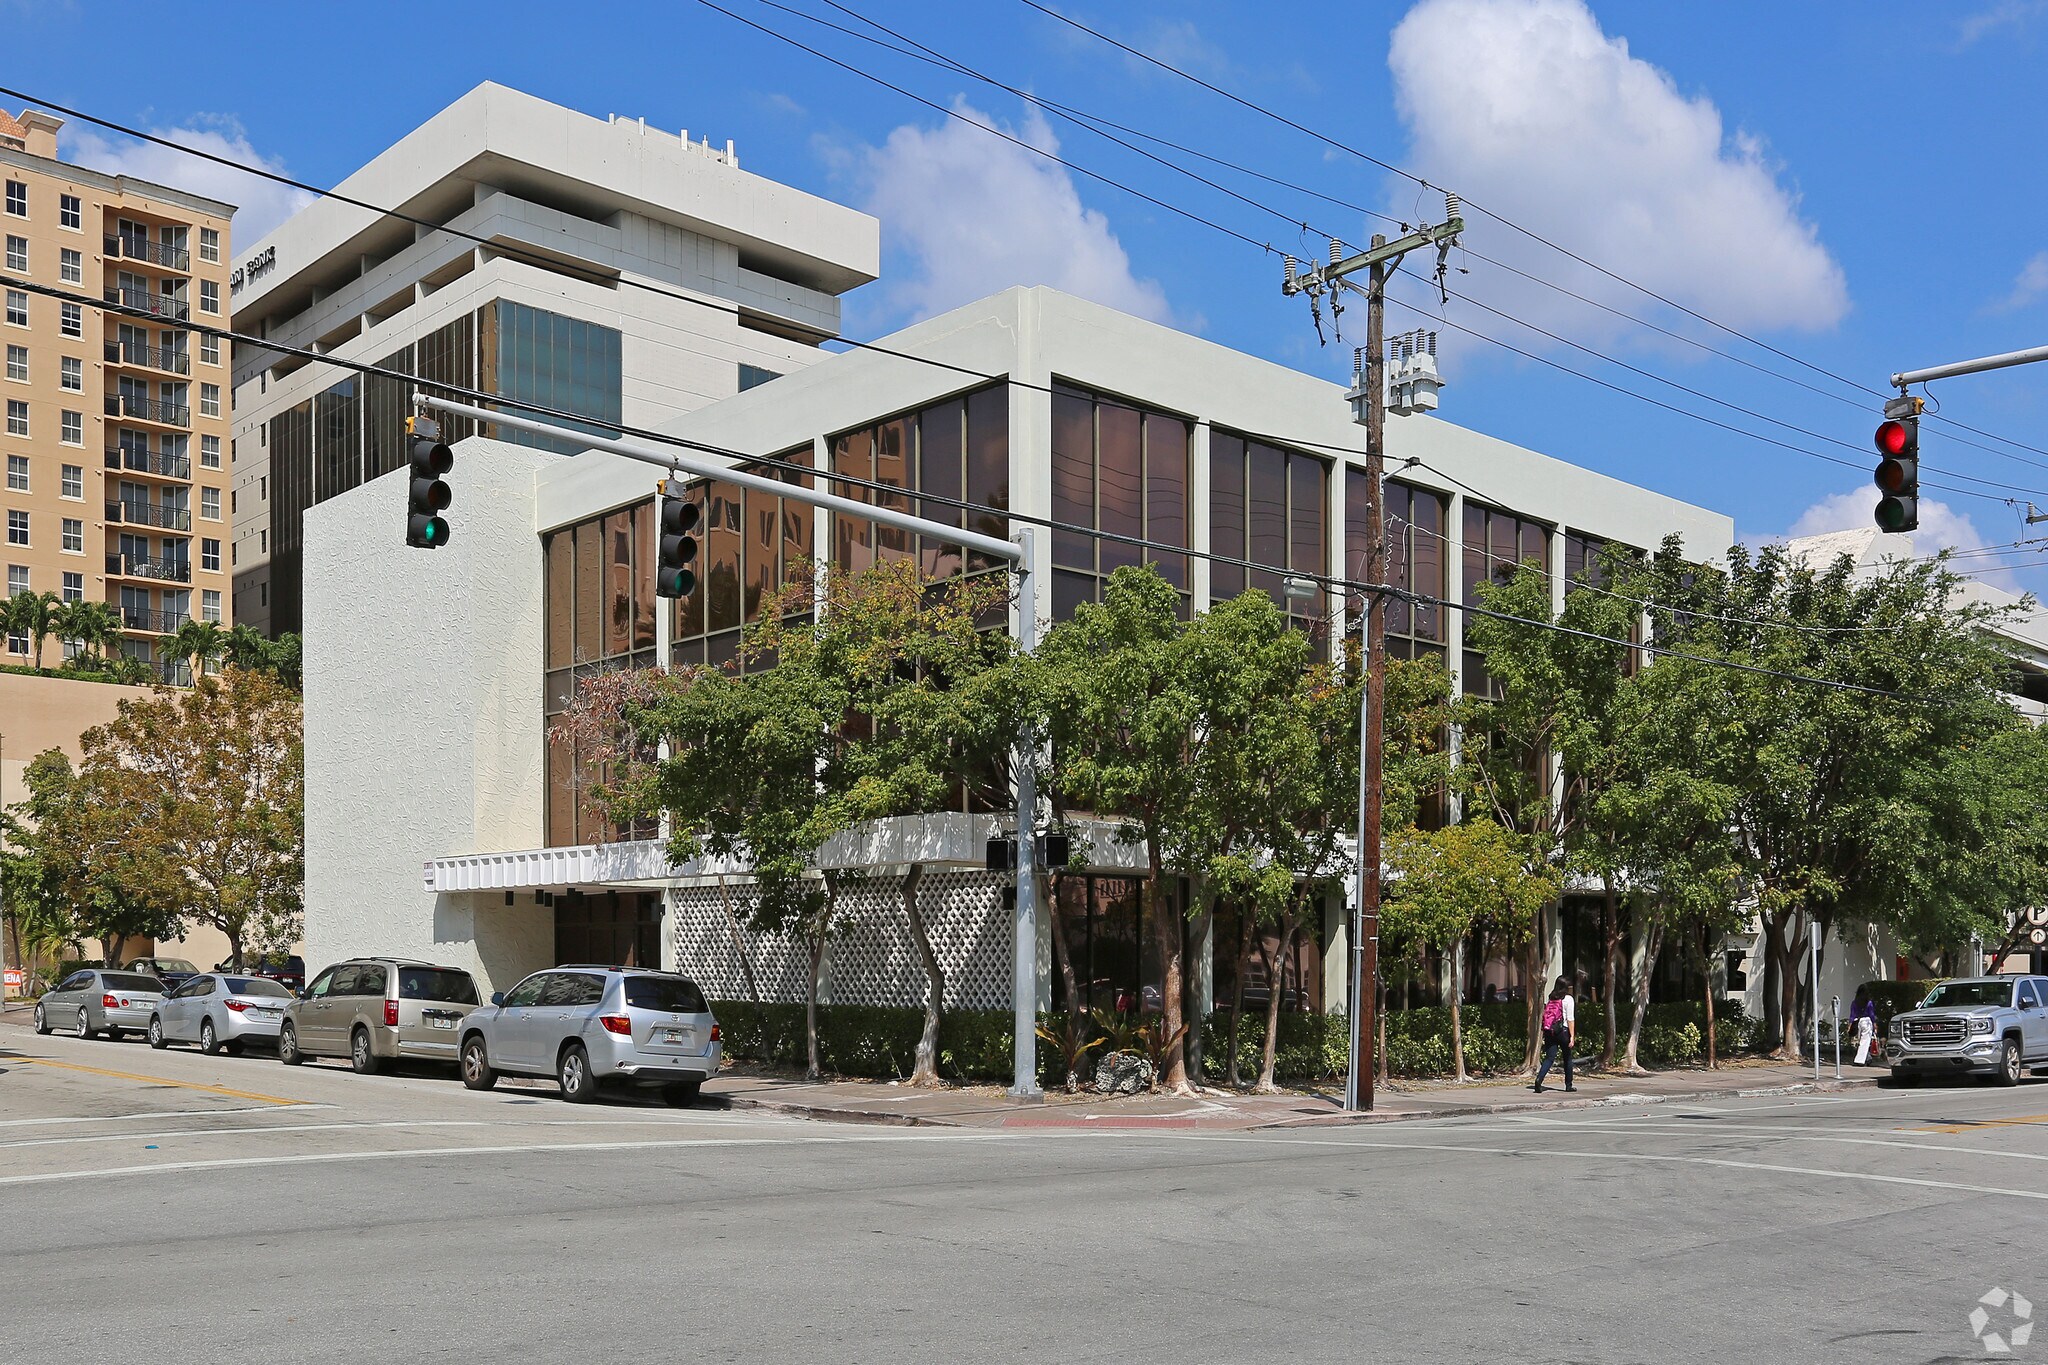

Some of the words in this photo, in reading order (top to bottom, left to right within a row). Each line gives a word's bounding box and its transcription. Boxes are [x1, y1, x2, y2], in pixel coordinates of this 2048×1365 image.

[246, 245, 276, 277] BANK
[2033, 904, 2046, 921] P
[1920, 1023, 1944, 1032] GMC
